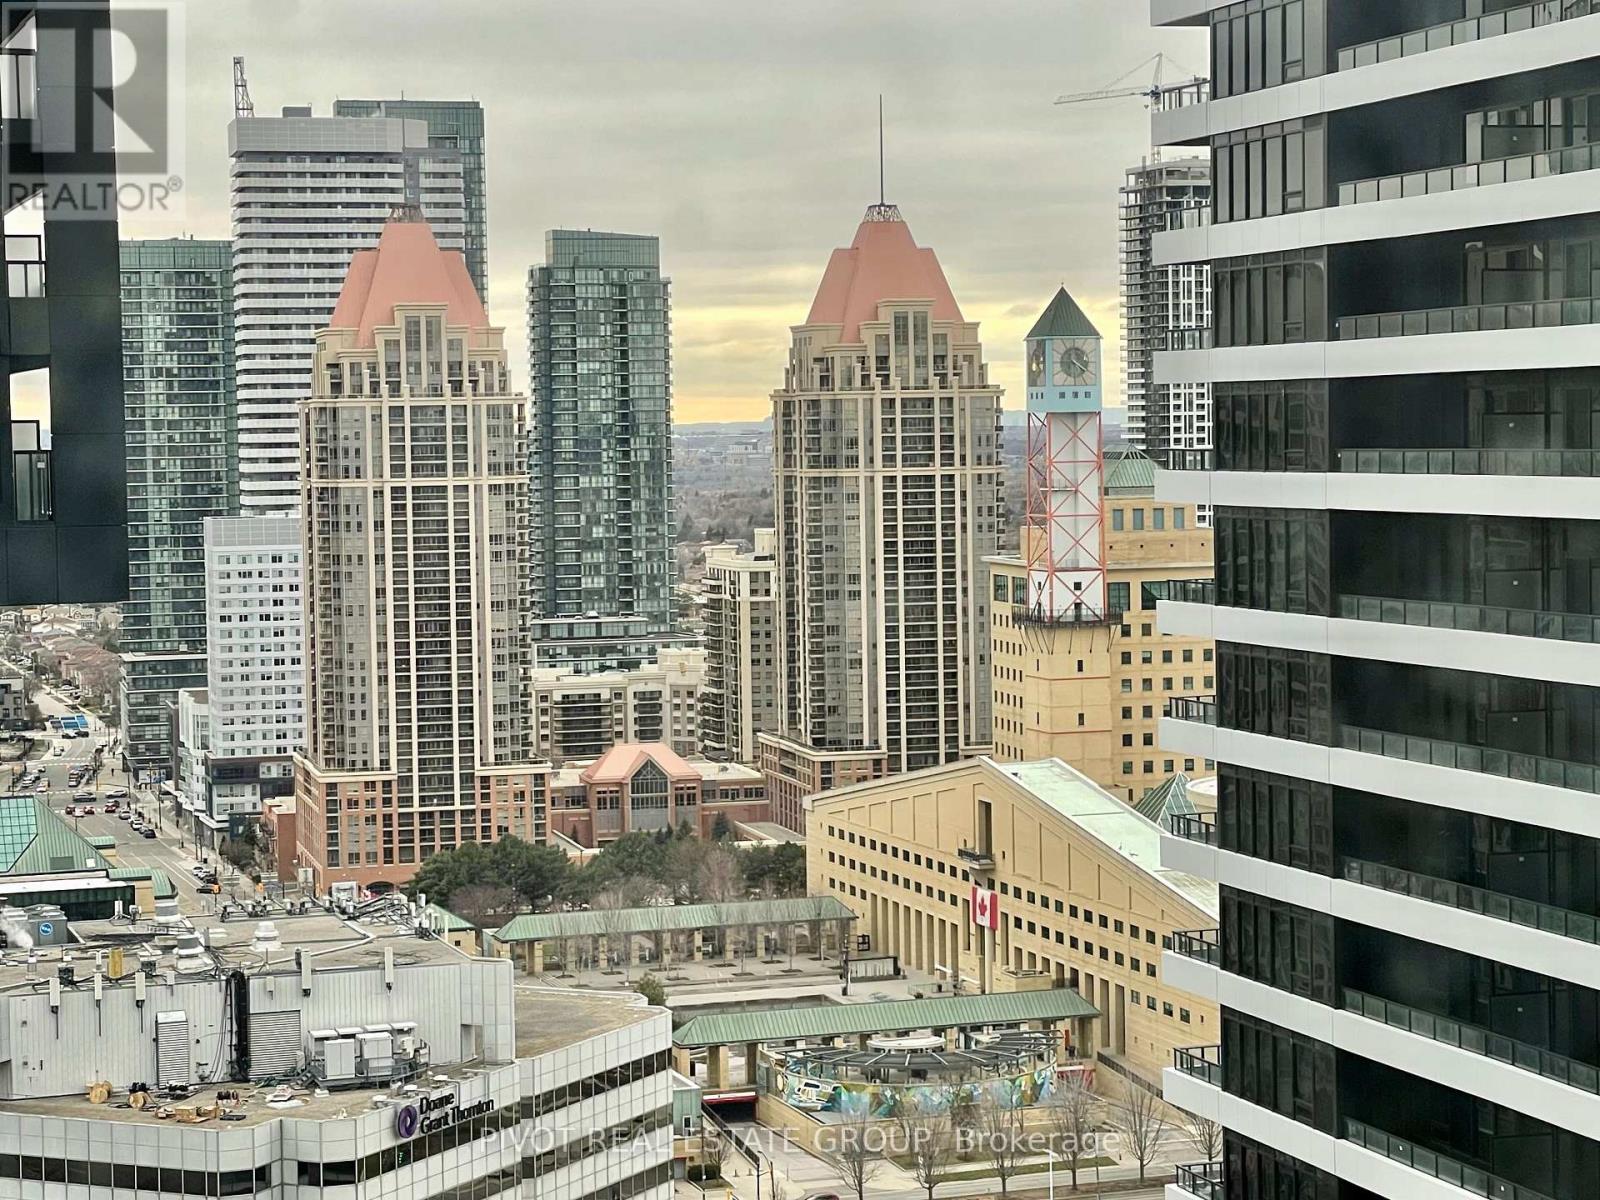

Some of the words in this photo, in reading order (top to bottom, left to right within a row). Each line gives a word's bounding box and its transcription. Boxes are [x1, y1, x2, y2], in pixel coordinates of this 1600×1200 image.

[420, 1092, 455, 1115] Doane
[420, 1112, 449, 1135] Grant
[450, 1098, 494, 1123] Thornton
